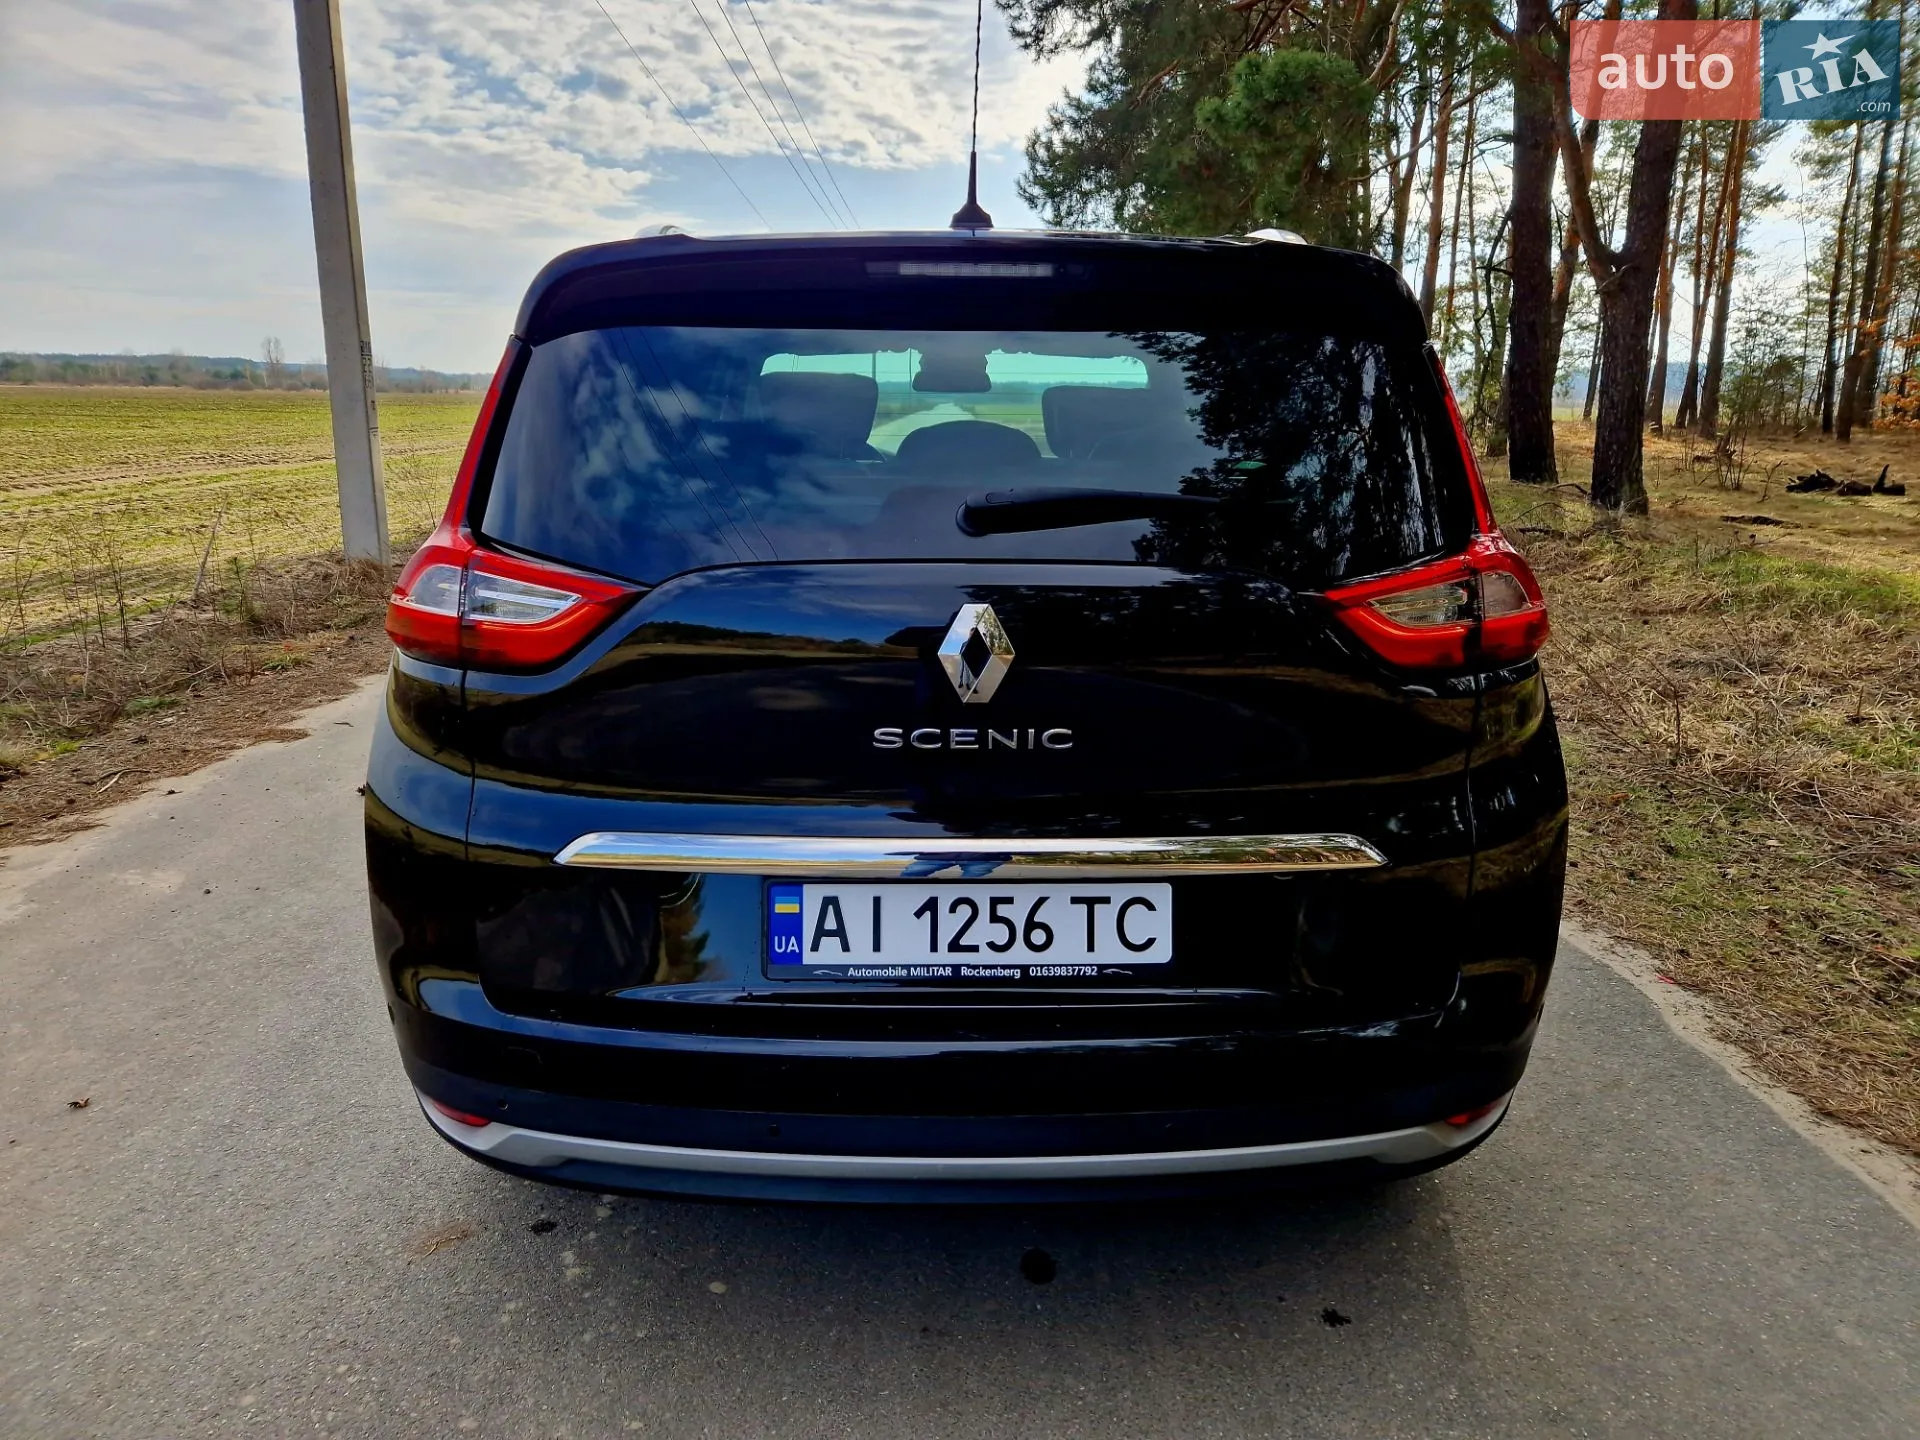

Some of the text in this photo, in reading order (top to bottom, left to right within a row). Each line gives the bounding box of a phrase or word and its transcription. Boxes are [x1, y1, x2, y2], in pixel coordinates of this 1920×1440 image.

[872, 727, 1074, 750] SCENIC
[809, 895, 1158, 953] AI 1256 TC
[774, 935, 800, 953] UA
[847, 965, 1098, 979] Automobile MILITAR Rockenberg 01639837792
